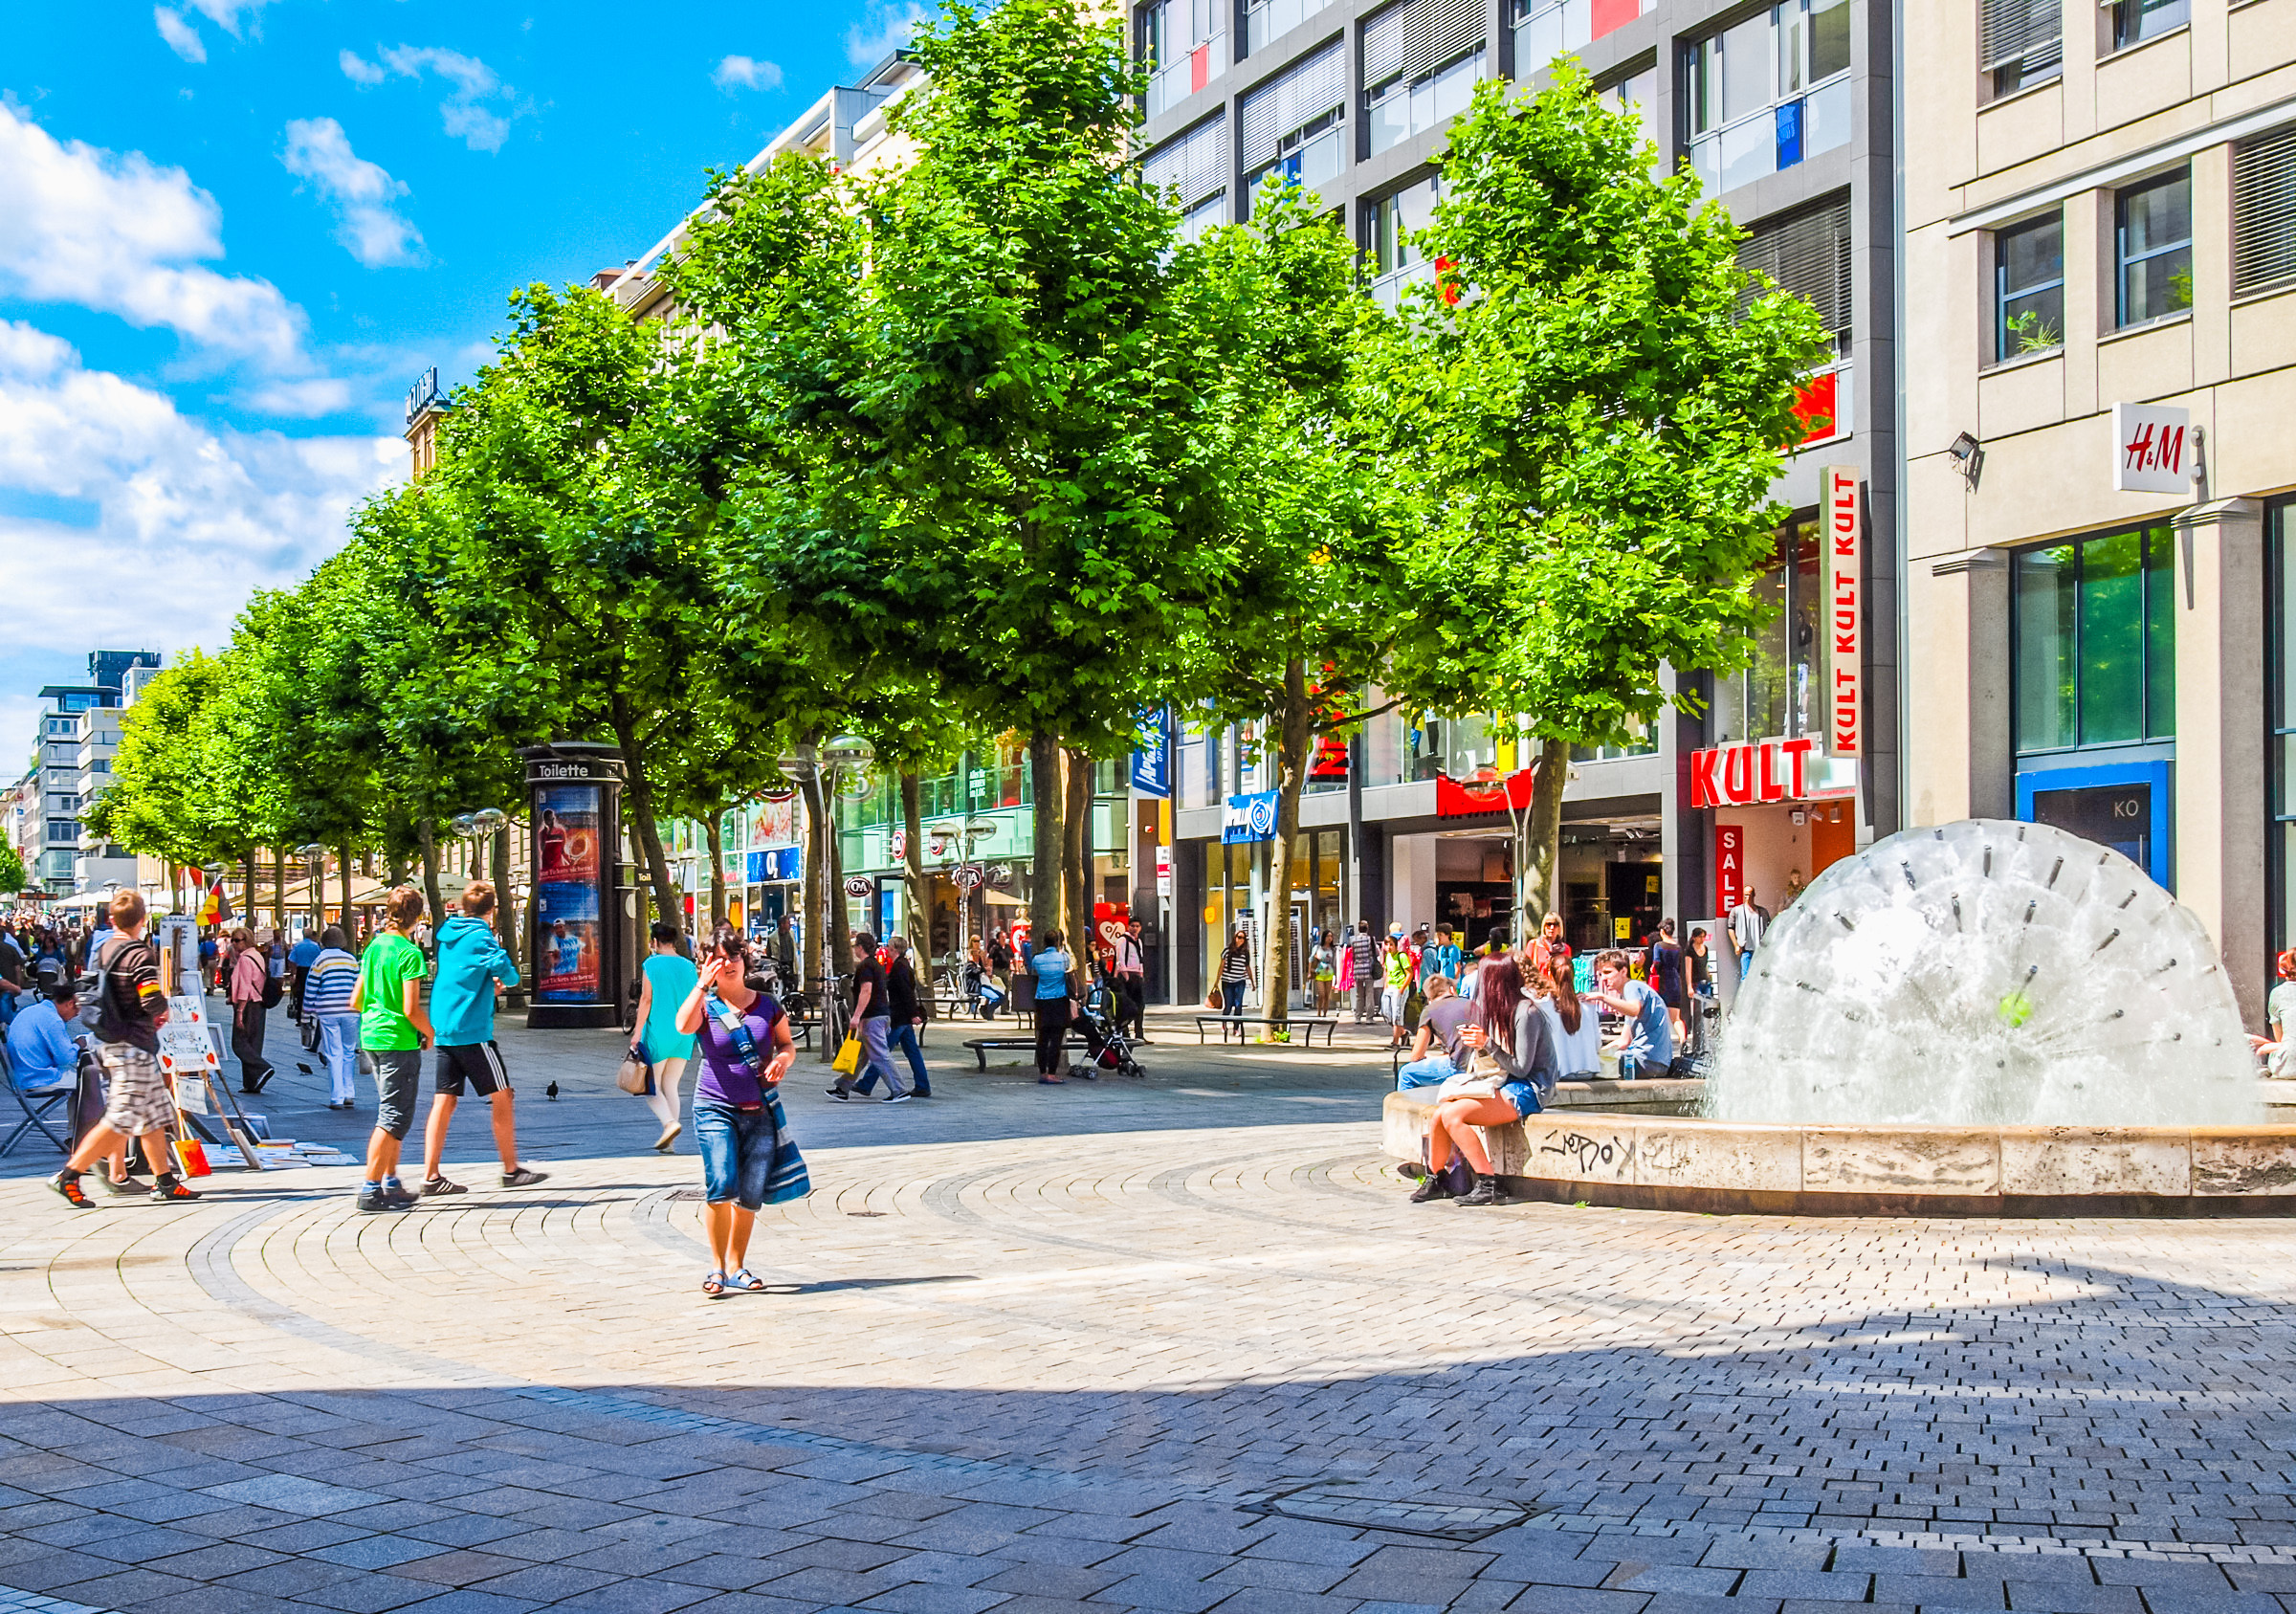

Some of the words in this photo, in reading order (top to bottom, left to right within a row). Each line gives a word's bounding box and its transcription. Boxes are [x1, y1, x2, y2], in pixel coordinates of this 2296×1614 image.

[2126, 423, 2184, 475] H&M
[1835, 473, 1854, 556] KULT
[1836, 570, 1855, 653] KULT
[1837, 668, 1856, 751] KULT
[539, 764, 588, 777] Toilette
[1691, 739, 1814, 807] KULT
[2114, 800, 2139, 817] KO
[1723, 831, 1736, 912] SALE
